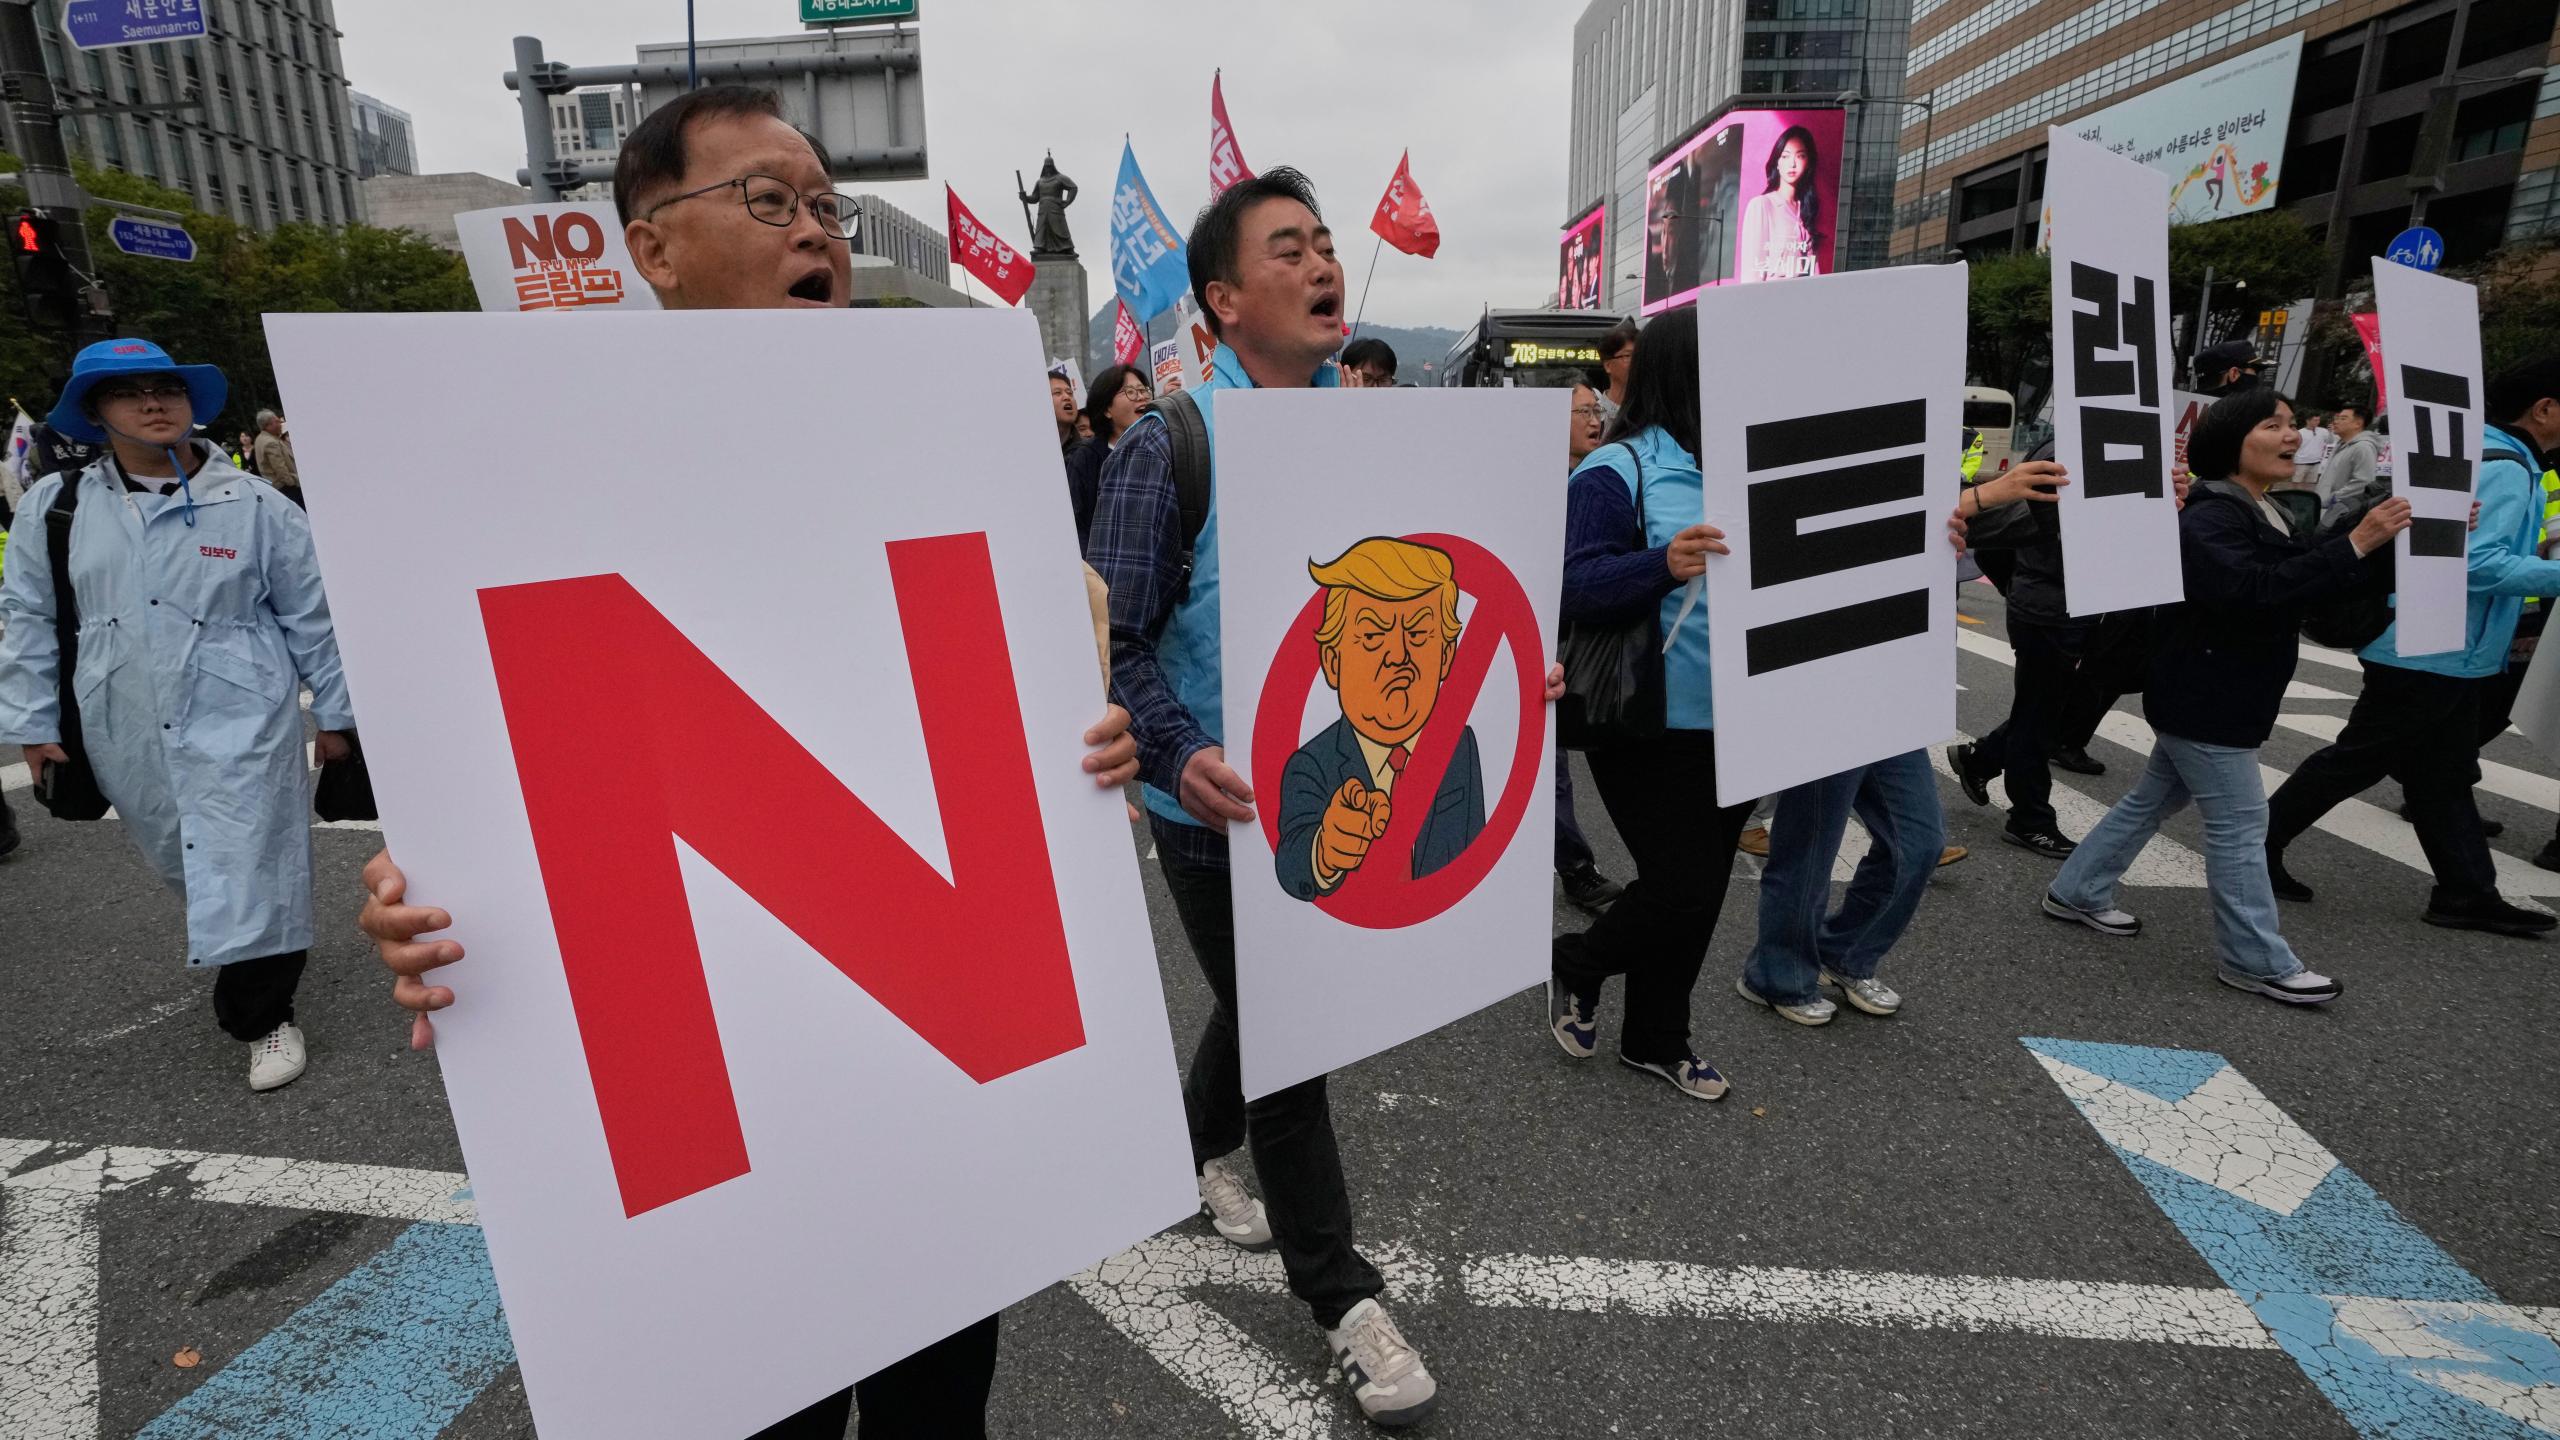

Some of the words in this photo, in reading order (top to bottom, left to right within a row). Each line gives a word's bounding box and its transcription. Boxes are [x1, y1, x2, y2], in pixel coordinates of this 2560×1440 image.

[122, 19, 200, 38] Saemunan-ro
[2166, 130, 2213, 155] 아름다운
[2217, 108, 2266, 141] 일이란다
[502, 212, 605, 269] NO
[527, 258, 598, 273] TRUMP!
[514, 268, 625, 311] 트럼프!
[1510, 343, 1537, 363] 703
[2070, 260, 2163, 499] 럼
[2400, 364, 2474, 557] 프
[199, 545, 237, 560] 진보당
[1746, 398, 1930, 677] 트
[476, 530, 1087, 1219] N
